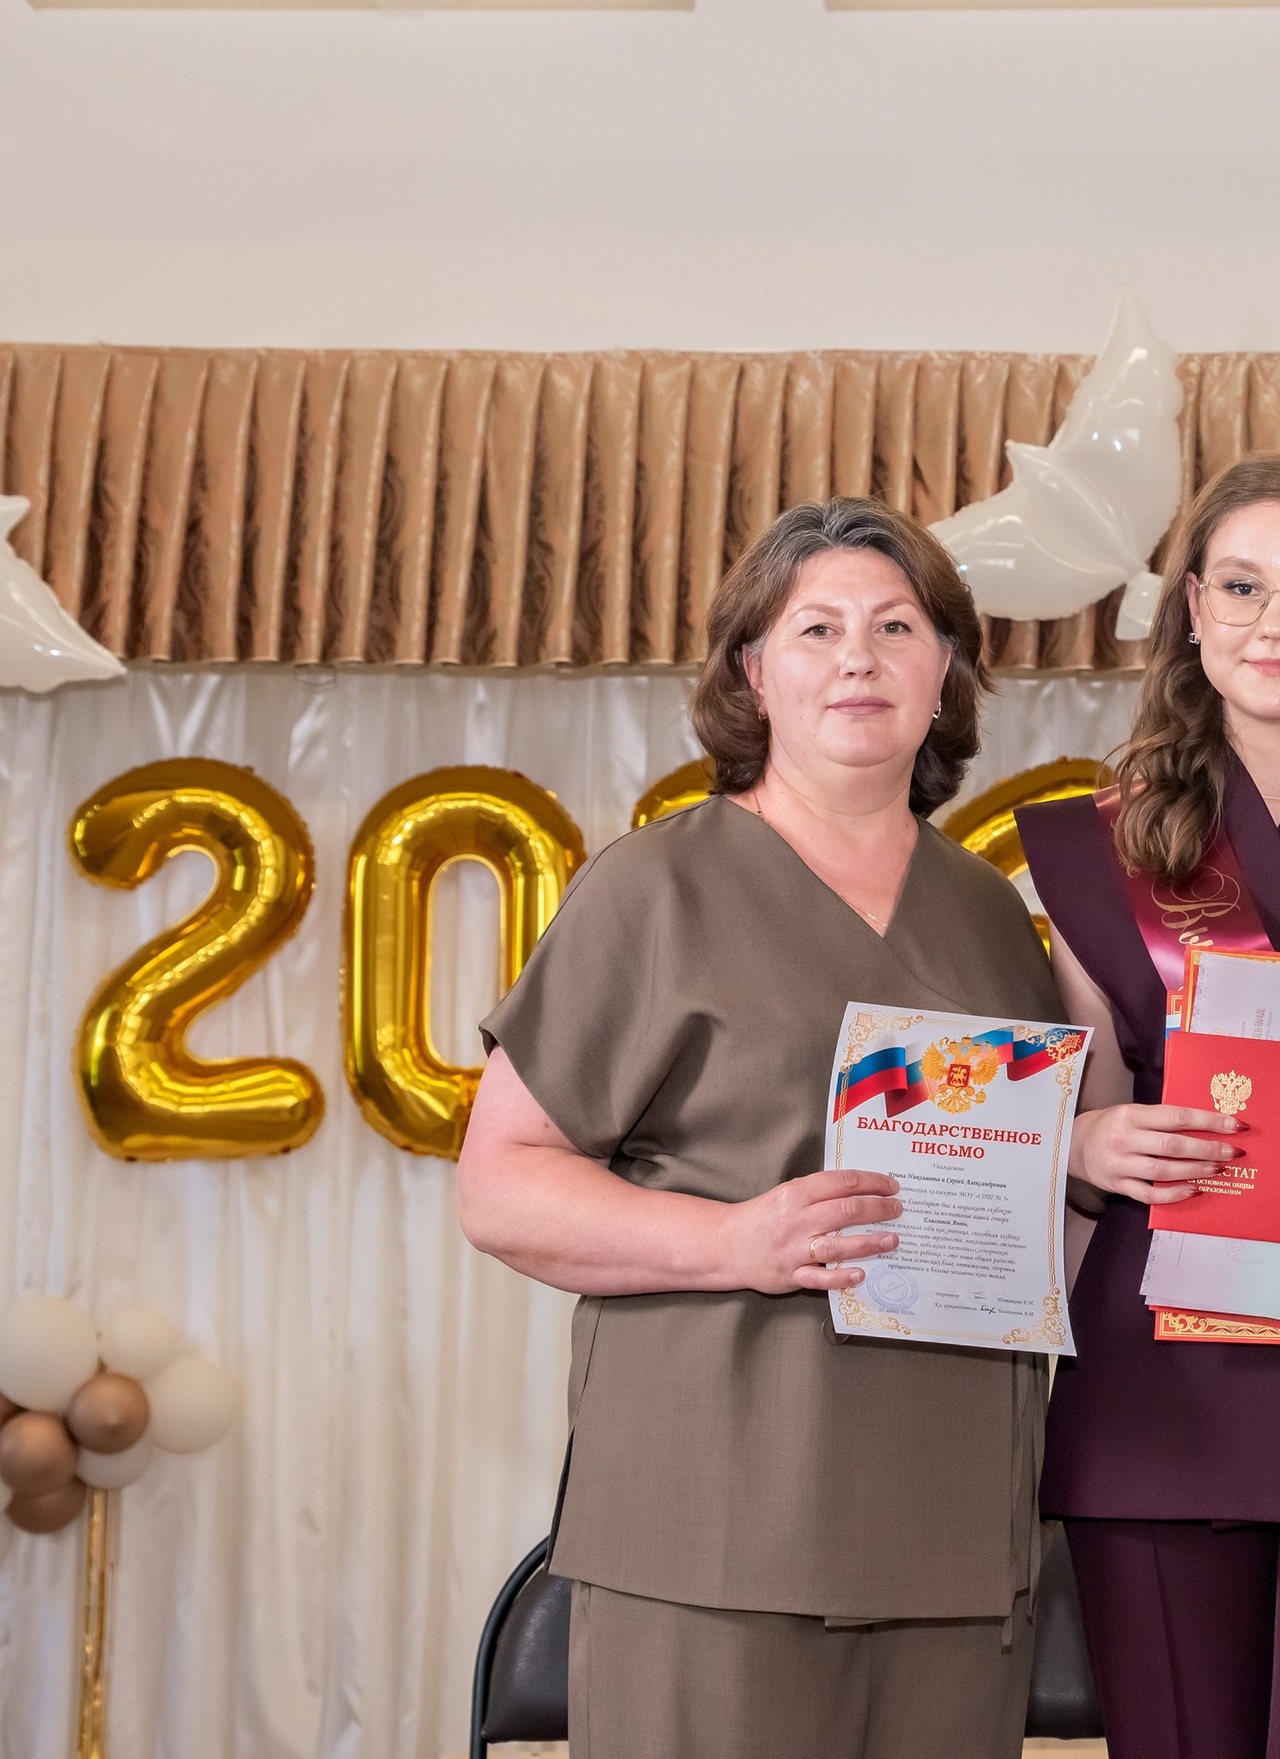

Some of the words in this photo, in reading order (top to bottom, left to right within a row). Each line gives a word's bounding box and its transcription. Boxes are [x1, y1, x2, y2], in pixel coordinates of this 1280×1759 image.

[857, 1116, 1042, 1145] БЛАГОДАРСТВЕННОЕ
[911, 1142, 985, 1158] ПИСЬМО
[931, 1163, 965, 1172] Уважаемые
[887, 1171, 906, 1179] Ирина
[906, 1173, 940, 1182] Николаевна
[945, 1177, 964, 1185] Сергей
[964, 1179, 1006, 1189] Александрович
[907, 1198, 939, 1208] благодарит
[956, 1205, 985, 1213] выражает
[985, 1206, 1013, 1216] глубокую
[970, 1229, 998, 1238] способная
[998, 1232, 1021, 1242] глубоко
